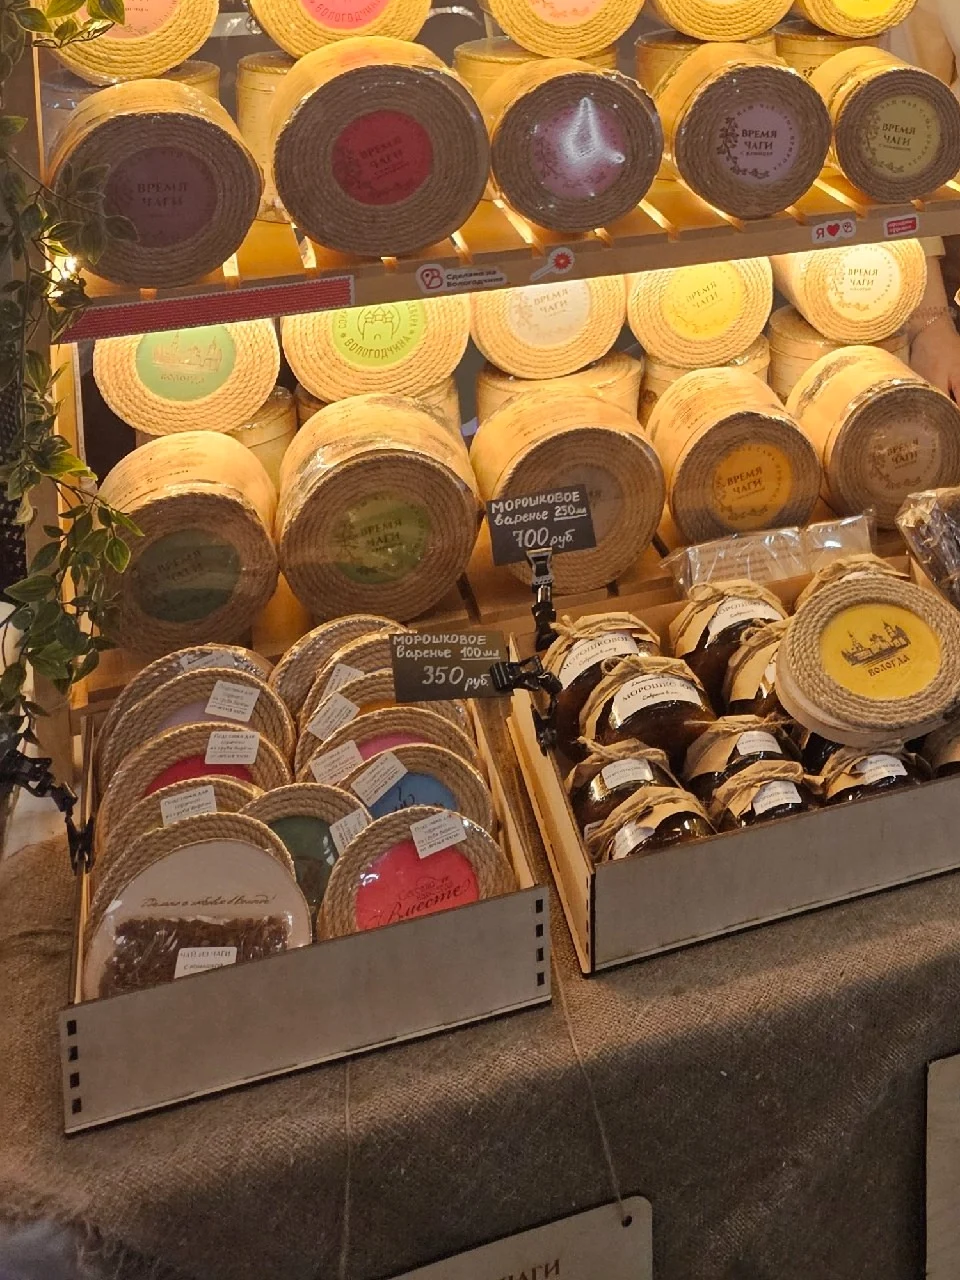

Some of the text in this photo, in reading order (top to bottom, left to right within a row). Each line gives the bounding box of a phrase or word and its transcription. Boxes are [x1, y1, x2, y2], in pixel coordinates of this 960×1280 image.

[741, 129, 777, 139] ВРЕМЯ
[882, 123, 916, 135] ВРЕМЯ
[744, 141, 773, 150] ЧАГИ
[884, 135, 911, 146] ЧАГИ
[816, 228, 825, 239] Я
[848, 268, 878, 276] ВРЕМЯ
[344, 335, 412, 360] ВОЛОГОДЧИНА
[727, 466, 763, 486] ВРЕМЯ
[733, 479, 762, 494] ЧАГИ
[491, 491, 580, 514] МОРОШКОВОЕ
[513, 527, 549, 548] 700
[393, 634, 487, 645] МОРОШКОВОЕ
[867, 654, 911, 678] ВОЛОГДА
[422, 665, 464, 685] 350
